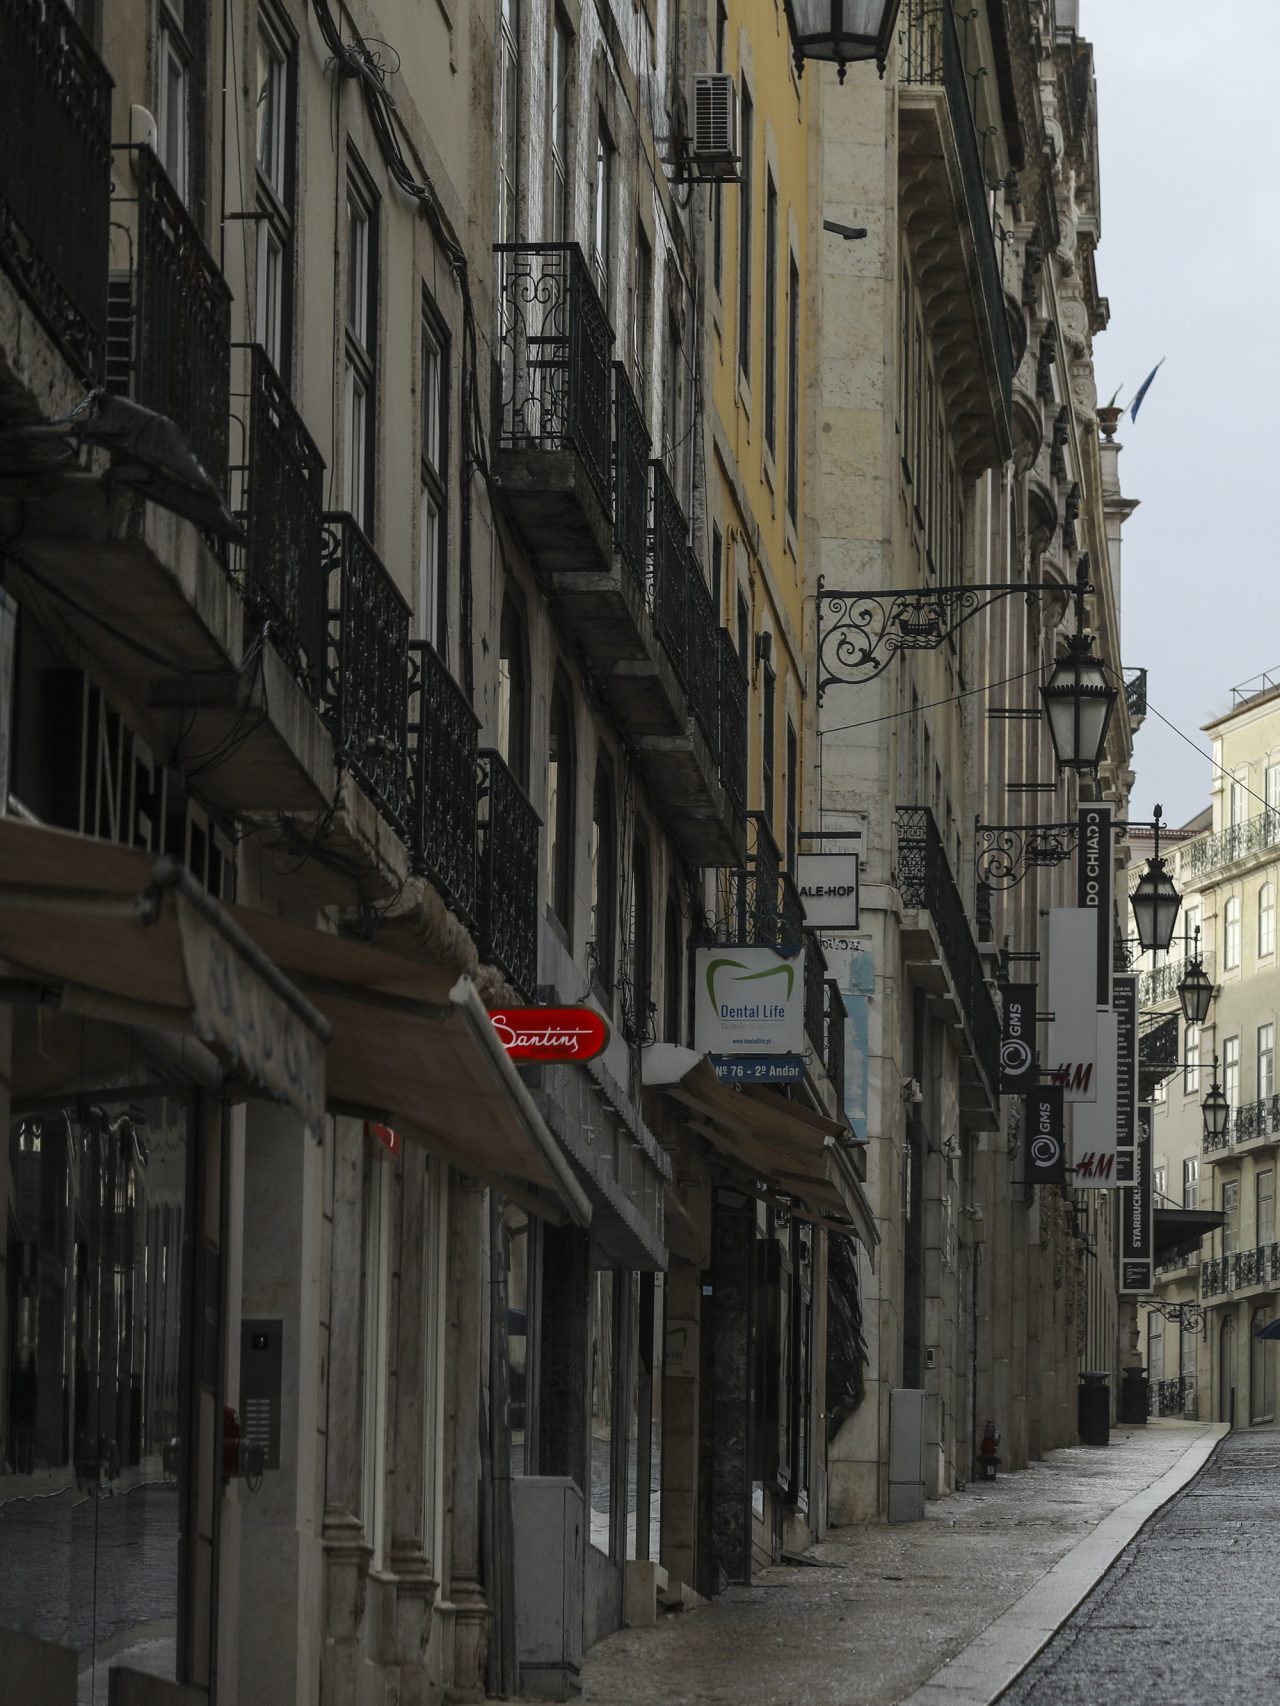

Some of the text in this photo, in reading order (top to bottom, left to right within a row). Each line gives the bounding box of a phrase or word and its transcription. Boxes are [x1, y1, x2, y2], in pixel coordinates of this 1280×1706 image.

[800, 886, 854, 897] ALE-HOP
[1086, 880, 1099, 905] DO
[721, 1004, 785, 1018] Dental Life
[1009, 1003, 1022, 1037] GMS
[731, 1065, 744, 1077] 76
[755, 1065, 767, 1077] 2º
[769, 1065, 800, 1077] Andar
[1040, 1101, 1051, 1133] GMS
